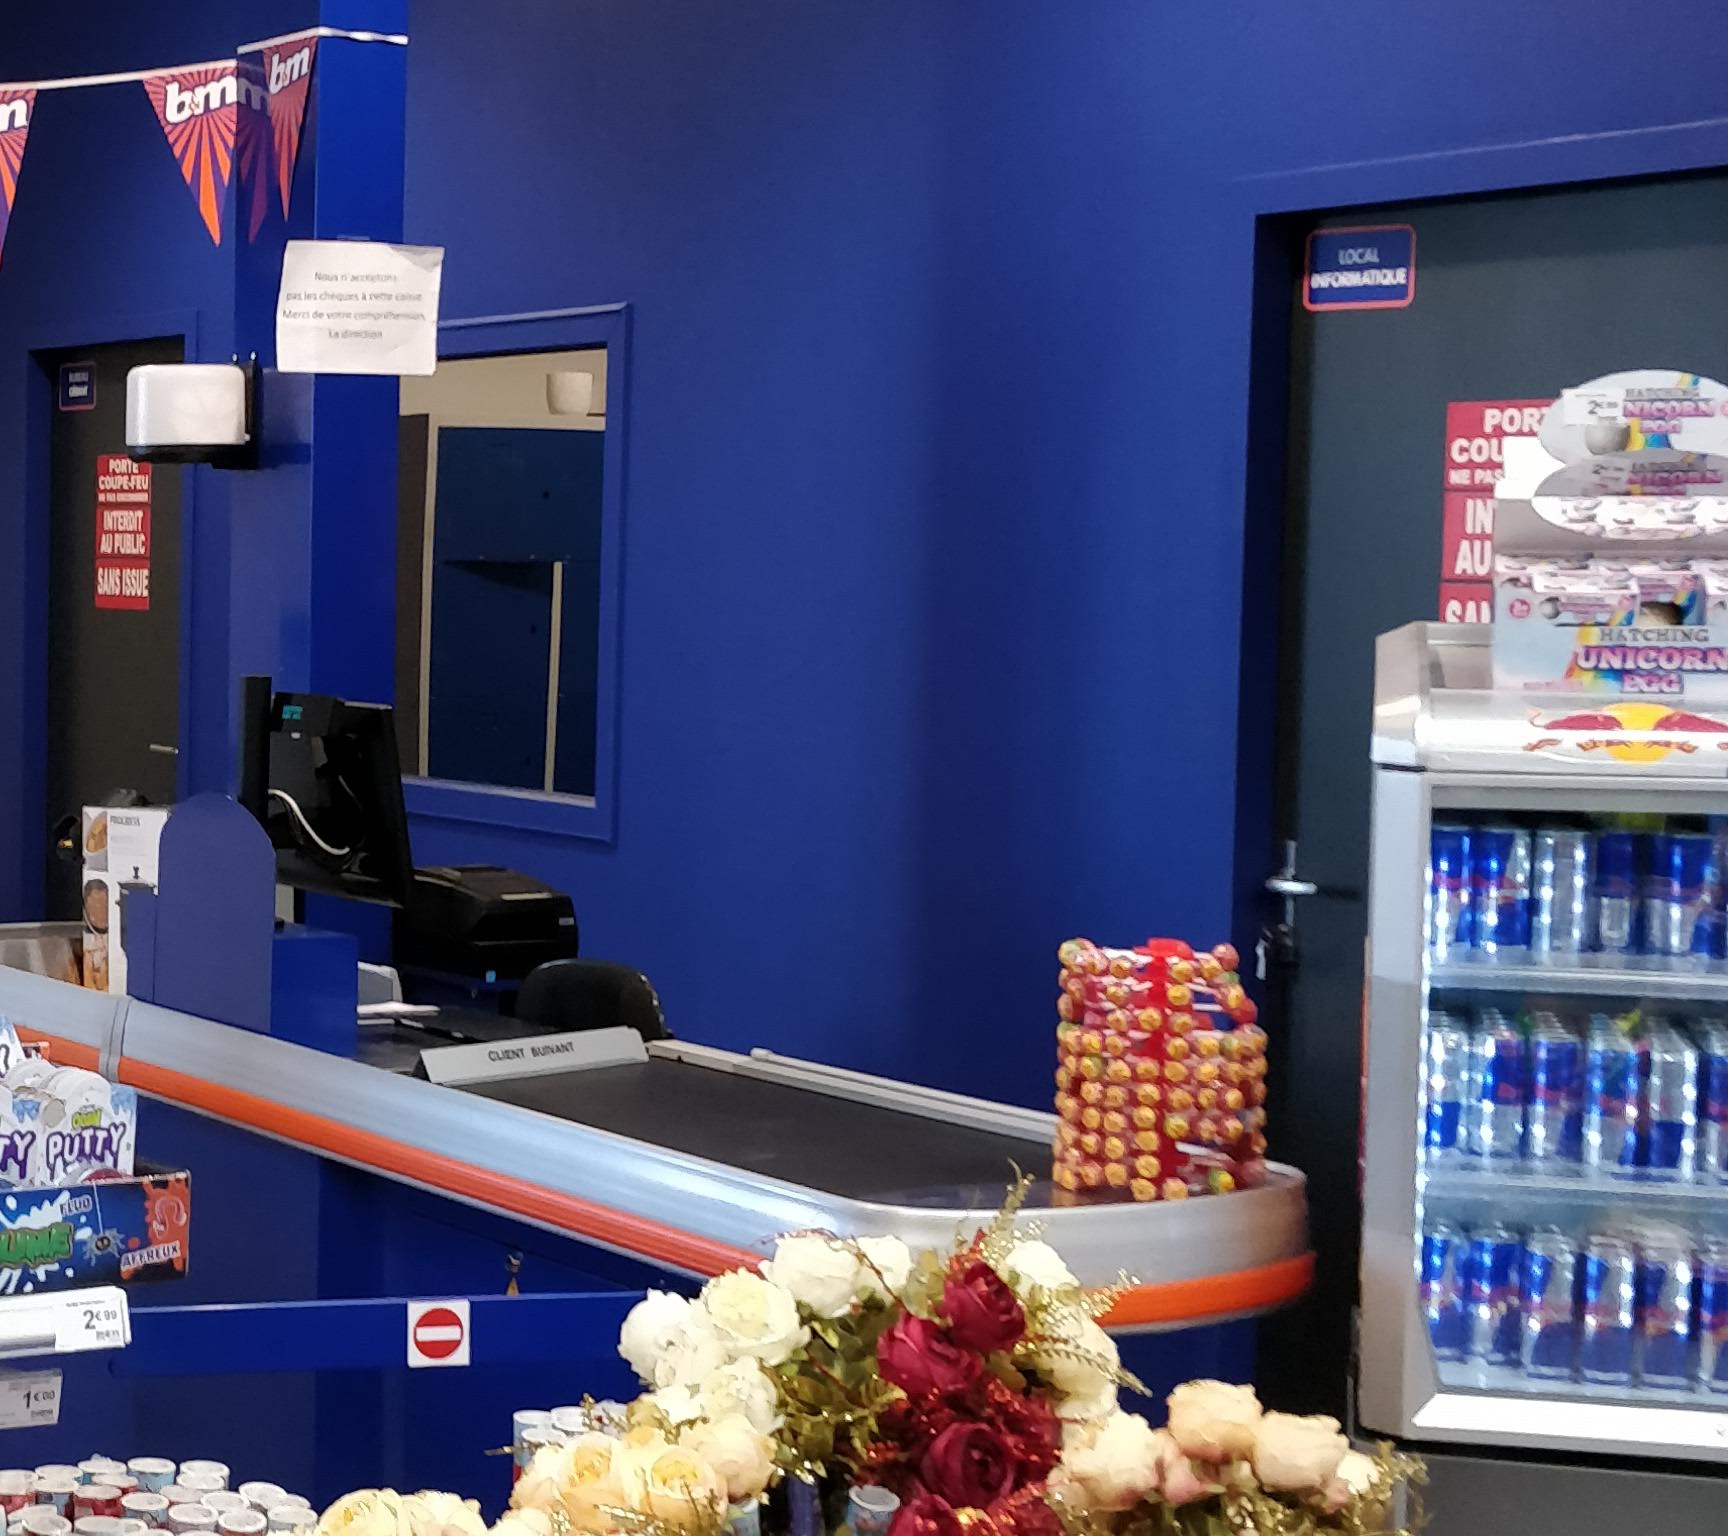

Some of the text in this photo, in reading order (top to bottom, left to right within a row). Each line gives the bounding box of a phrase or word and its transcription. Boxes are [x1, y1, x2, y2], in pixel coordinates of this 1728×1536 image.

[1337, 247, 1380, 265] LOCAL
[1310, 267, 1408, 289] INFORMATIQUE
[1483, 407, 1550, 434] POR
[103, 510, 144, 532] INTERDIT
[100, 533, 145, 555] AU PUBLIC
[97, 567, 150, 598] SANS ISSUE
[1599, 627, 1710, 643] HATCHING
[1576, 645, 1728, 672] UNICORN
[1622, 673, 1684, 695] EGG
[487, 1047, 525, 1062] CLIENT
[47, 1122, 127, 1170] PUTTY
